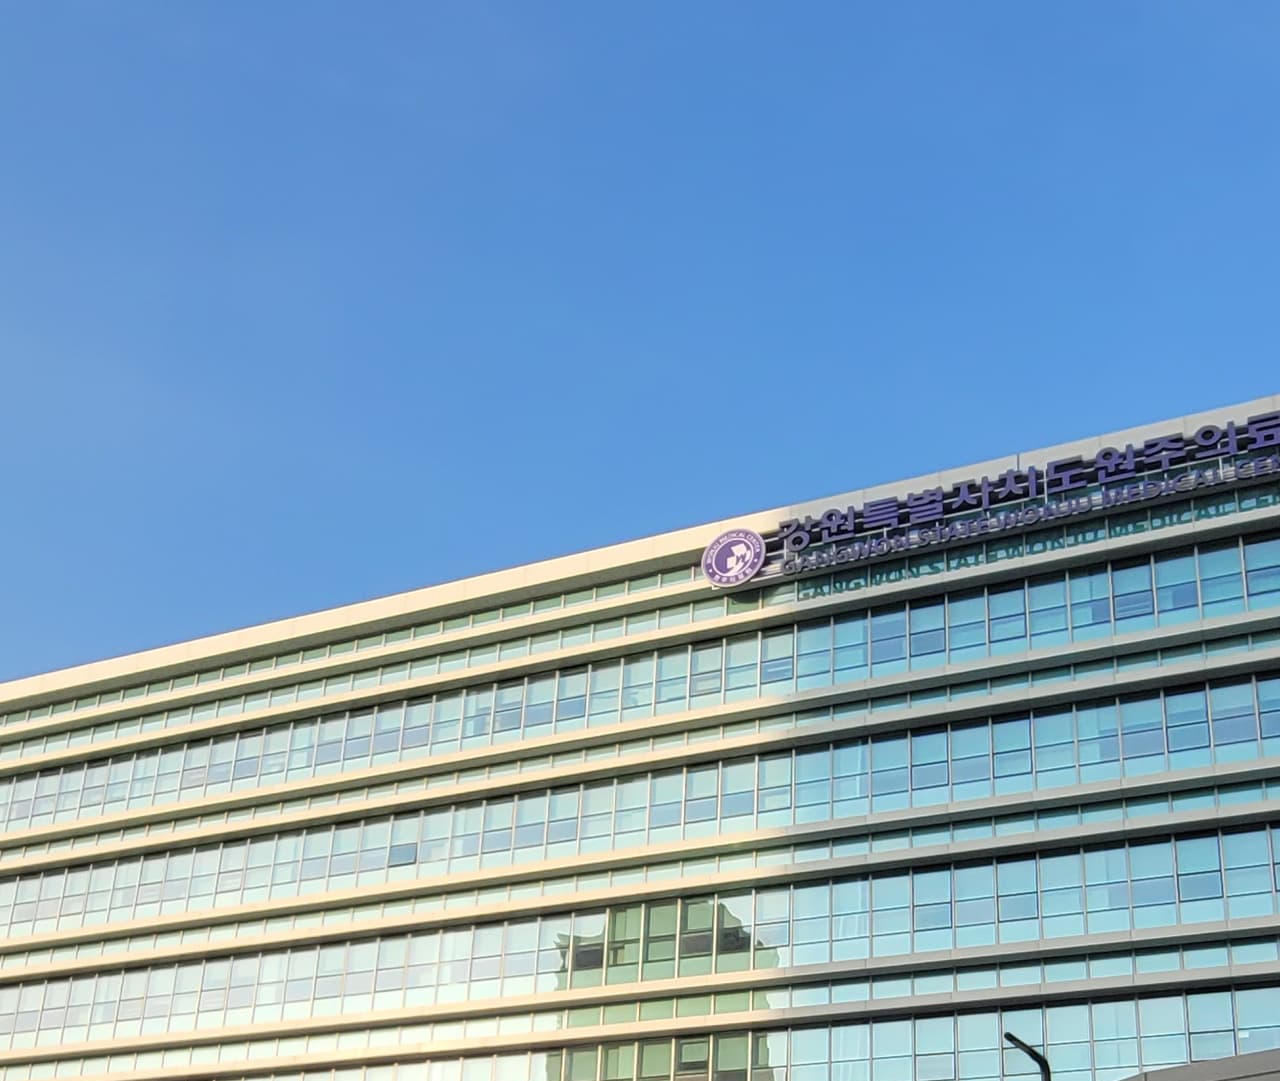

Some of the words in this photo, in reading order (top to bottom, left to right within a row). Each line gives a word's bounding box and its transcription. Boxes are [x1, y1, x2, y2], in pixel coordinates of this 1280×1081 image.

[780, 534, 913, 576] GANGWON
[920, 511, 989, 546] STATE
[990, 494, 1092, 530] WONJU
[1102, 465, 1226, 507] MEDICAL
